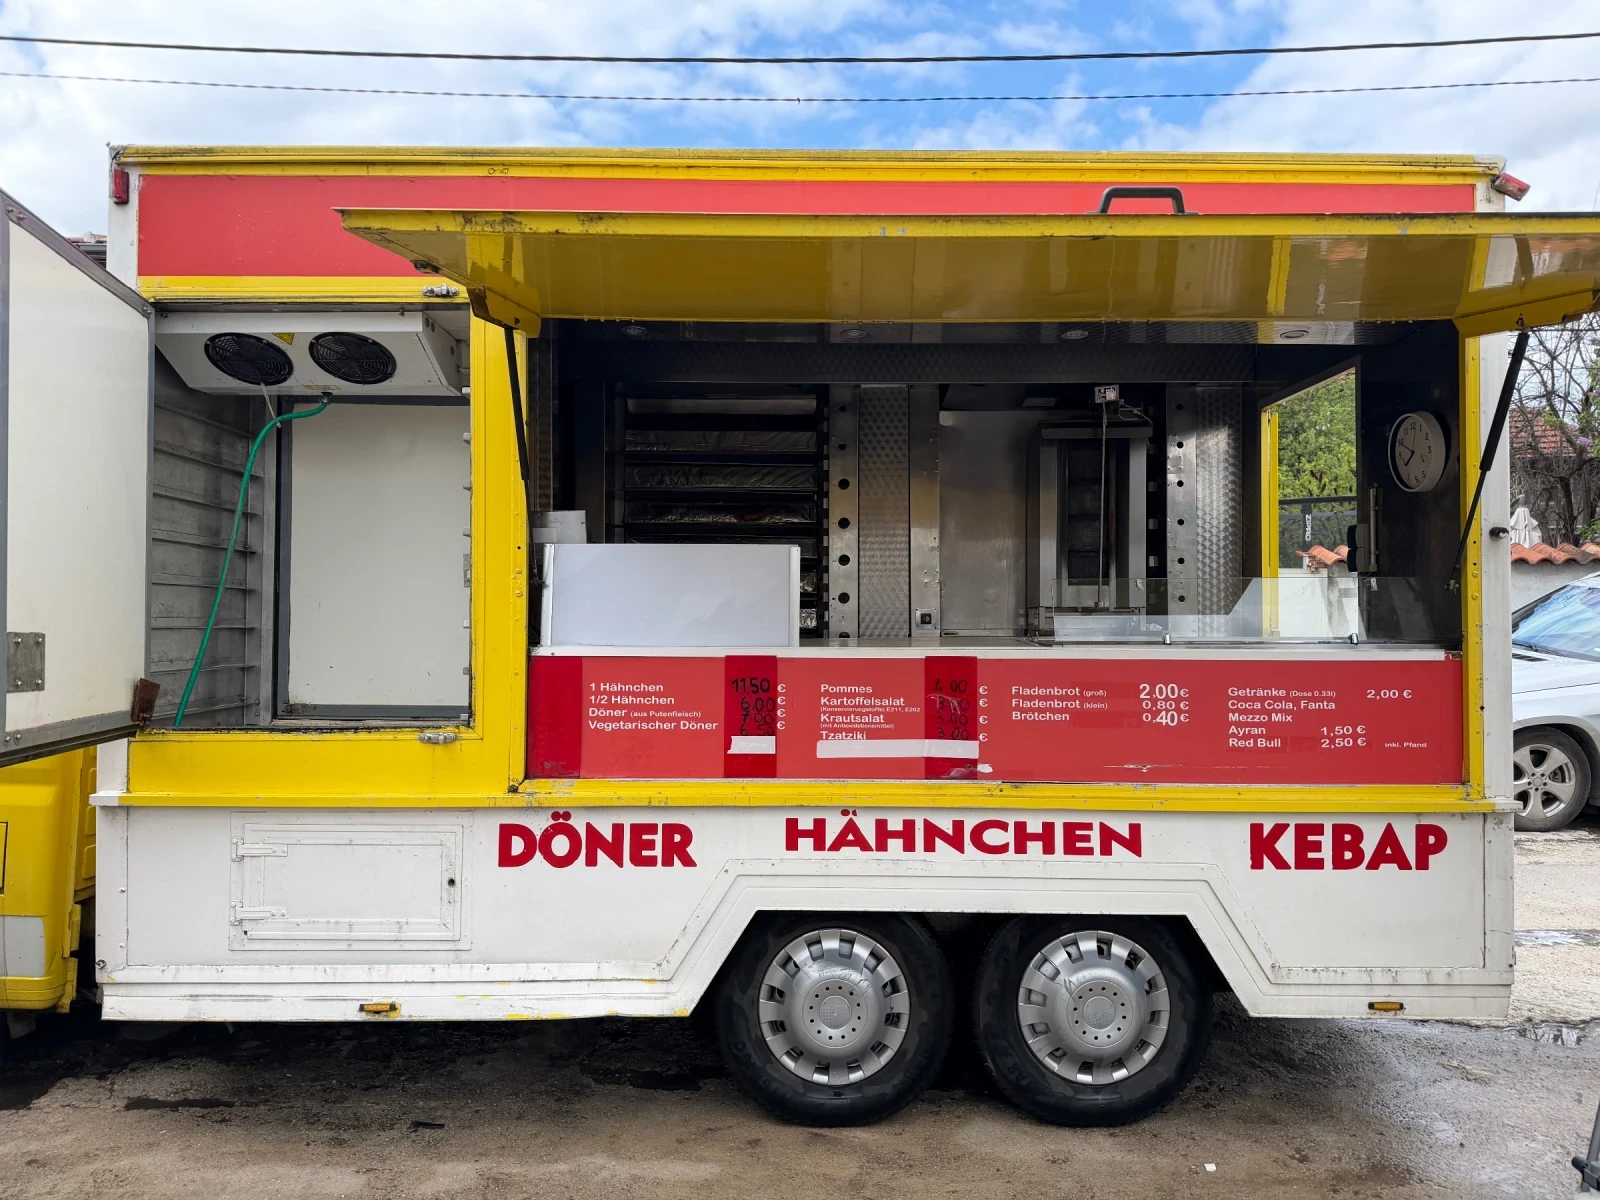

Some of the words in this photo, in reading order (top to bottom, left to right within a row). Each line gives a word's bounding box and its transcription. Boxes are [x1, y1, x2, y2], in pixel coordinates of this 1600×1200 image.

[590, 683, 595, 691] 1
[601, 683, 664, 692] Hähnchen
[732, 677, 770, 695] 11,50
[777, 684, 786, 693] €
[820, 684, 873, 693] Pommes
[979, 686, 988, 694] €
[1012, 686, 1080, 696] Fladenbrot
[1139, 684, 1179, 699] 2,00
[1180, 688, 1189, 697] €
[1228, 687, 1286, 697] Getränke
[1366, 690, 1399, 700] 2,00
[1403, 690, 1412, 699] €
[590, 696, 608, 704] 1/2
[612, 695, 675, 704] Hähnchen
[777, 696, 786, 705] €
[820, 697, 905, 706] Kartoffelsalat
[979, 699, 988, 707] €
[1012, 699, 1080, 708] Fladenbrot
[1142, 700, 1175, 711] 0,80
[1180, 701, 1189, 710] €
[1228, 700, 1261, 709] Coca
[1264, 700, 1297, 711] Cola,
[1300, 700, 1336, 709] Fanta
[589, 707, 628, 717] Döner
[777, 708, 786, 717] €
[1012, 711, 1070, 721] Brötchen
[820, 713, 885, 723] Krautsalat
[979, 715, 988, 724] €
[1142, 711, 1178, 726] 0,40
[1180, 713, 1189, 722] €
[1228, 713, 1268, 722] Mezzo
[1271, 713, 1293, 722] Mix
[589, 721, 676, 731] Vegetarischer
[680, 720, 719, 730] Döner
[777, 721, 786, 730] €
[820, 731, 867, 740] Tzatziki
[1228, 726, 1266, 737] Ayran
[1320, 726, 1353, 737] 1,50
[1357, 725, 1366, 734] €
[979, 733, 988, 742] €
[1229, 738, 1254, 747] Red
[1257, 738, 1281, 747] Bull
[1321, 738, 1353, 749] 2,50
[1357, 738, 1366, 747] €
[498, 810, 697, 869] DÖNER
[785, 808, 1142, 858] HÄHNCHEN
[1249, 822, 1448, 871] KEBAP
